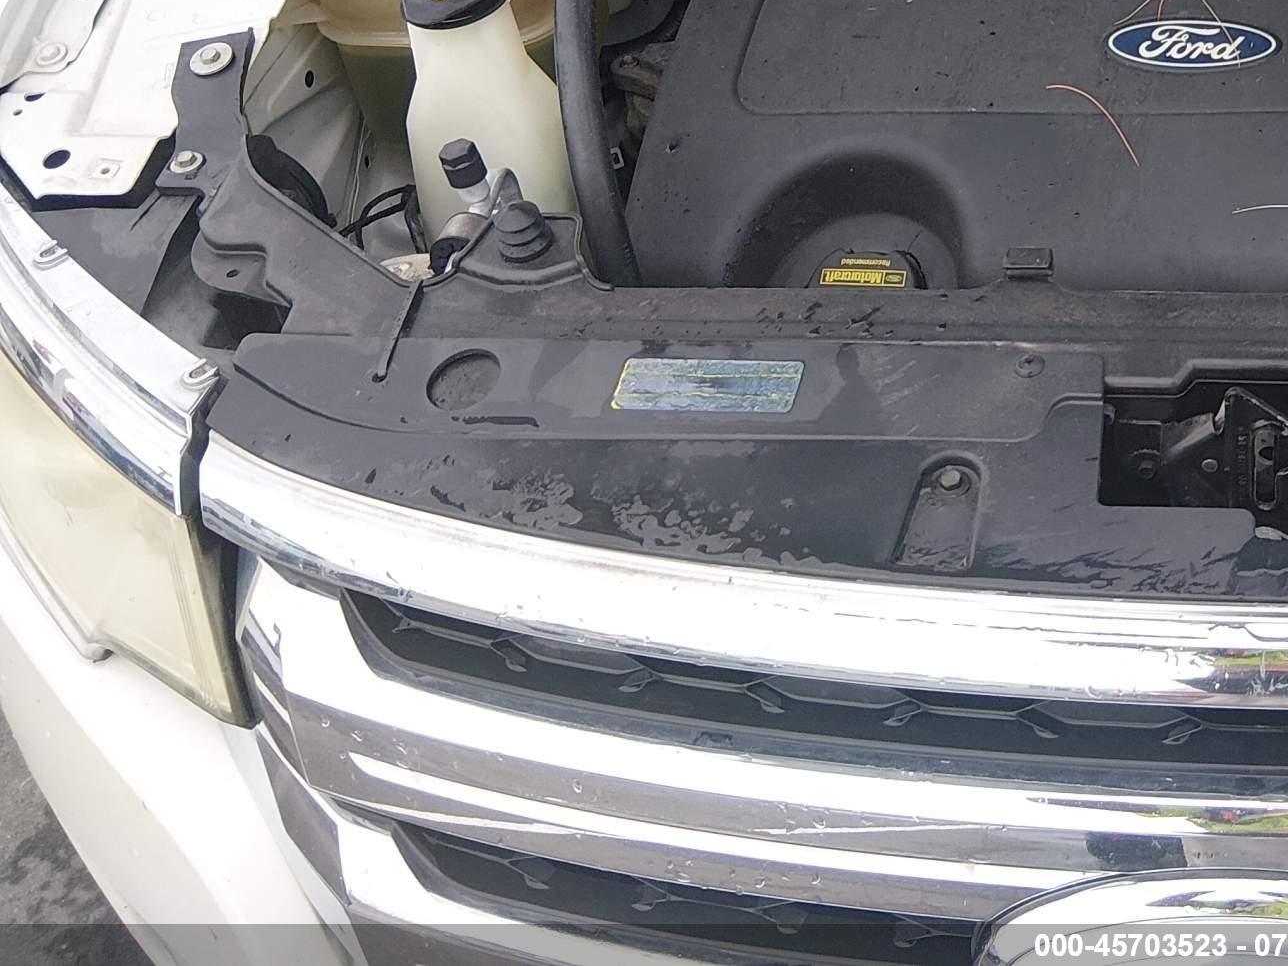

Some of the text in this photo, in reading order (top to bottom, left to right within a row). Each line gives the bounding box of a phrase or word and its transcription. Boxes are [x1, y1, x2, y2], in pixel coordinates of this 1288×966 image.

[1138, 25, 1246, 60] Ford
[840, 258, 892, 267] Recommended
[824, 271, 883, 284] Motorcraft
